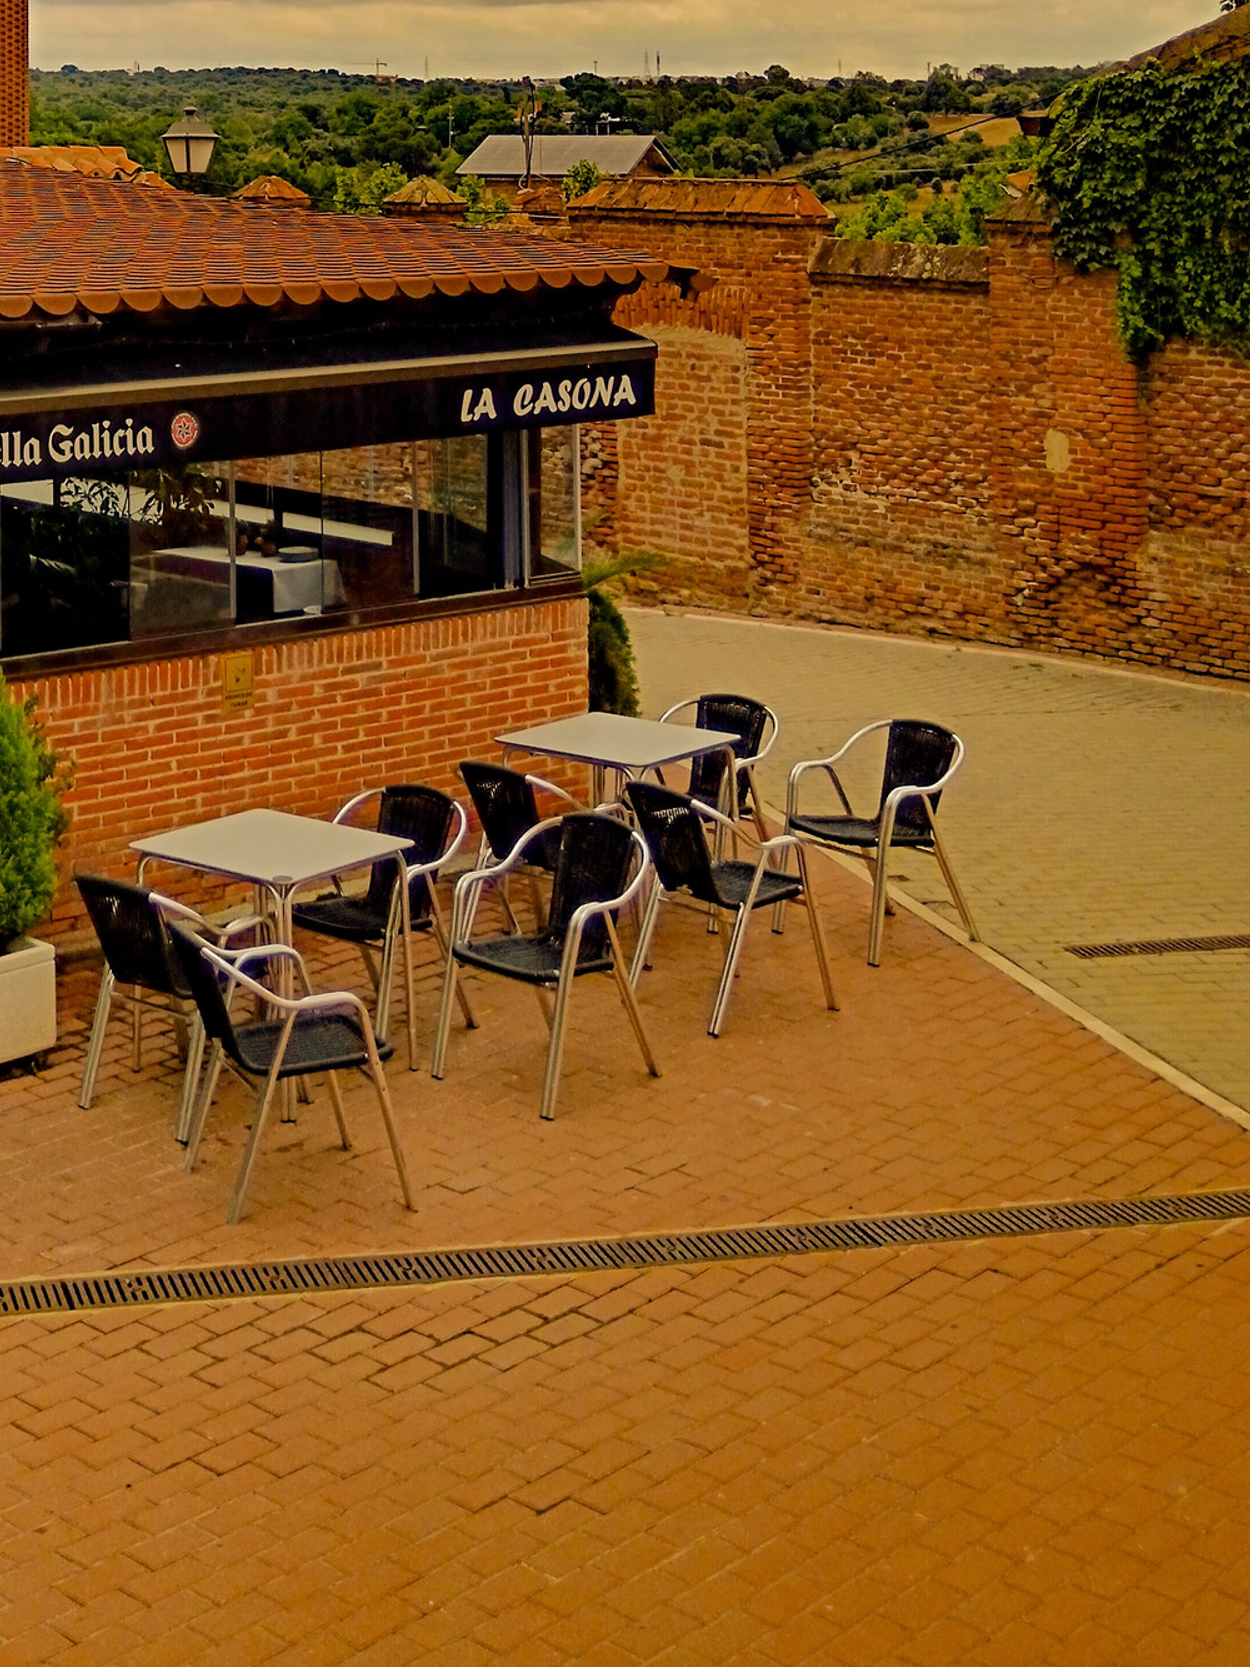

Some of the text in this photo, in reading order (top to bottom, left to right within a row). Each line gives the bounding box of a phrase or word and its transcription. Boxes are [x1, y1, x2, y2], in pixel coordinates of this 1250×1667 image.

[460, 374, 637, 423] LA CASONA
[48, 418, 155, 464] Galicia
